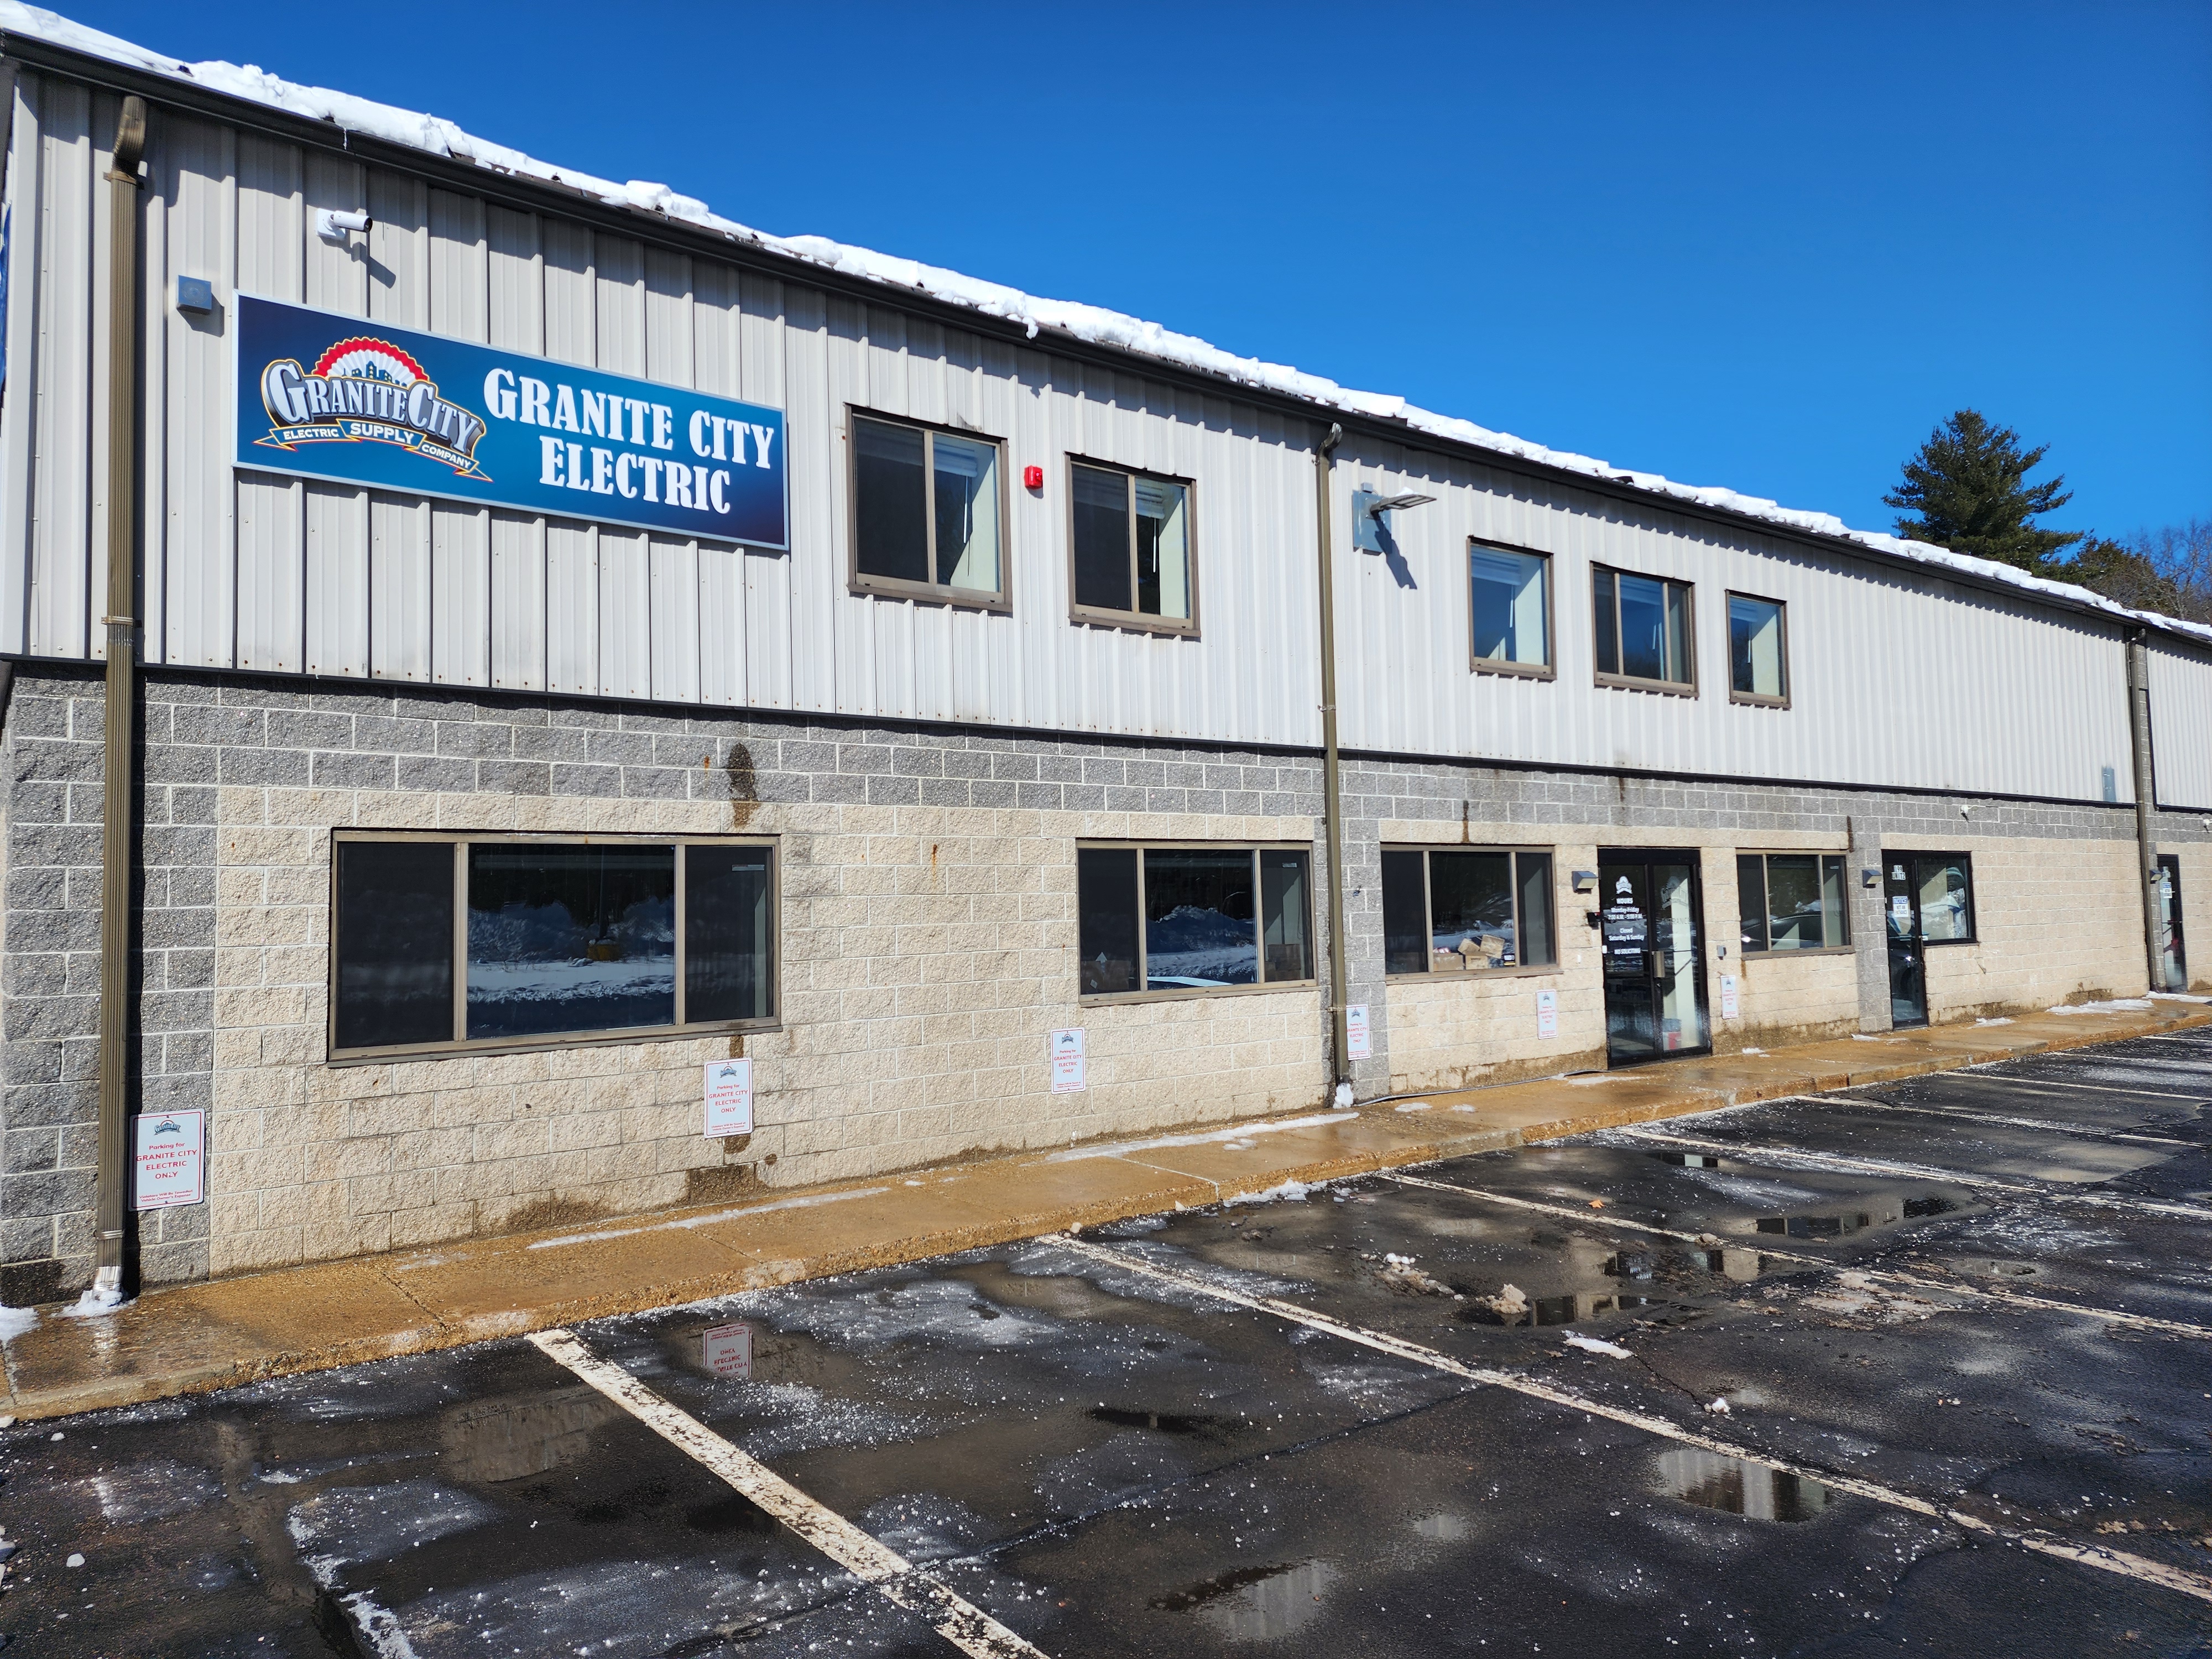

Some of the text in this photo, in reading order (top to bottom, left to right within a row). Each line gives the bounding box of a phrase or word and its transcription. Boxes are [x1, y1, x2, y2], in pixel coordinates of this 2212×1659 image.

[483, 368, 774, 469] GRANITE CITY
[283, 423, 472, 470] ELECTRIC SUPPLY COMPANY
[539, 435, 731, 514] ELECTRIC
[136, 1152, 175, 1161] GRANITE
[146, 1160, 187, 1170] ELECTRIC
